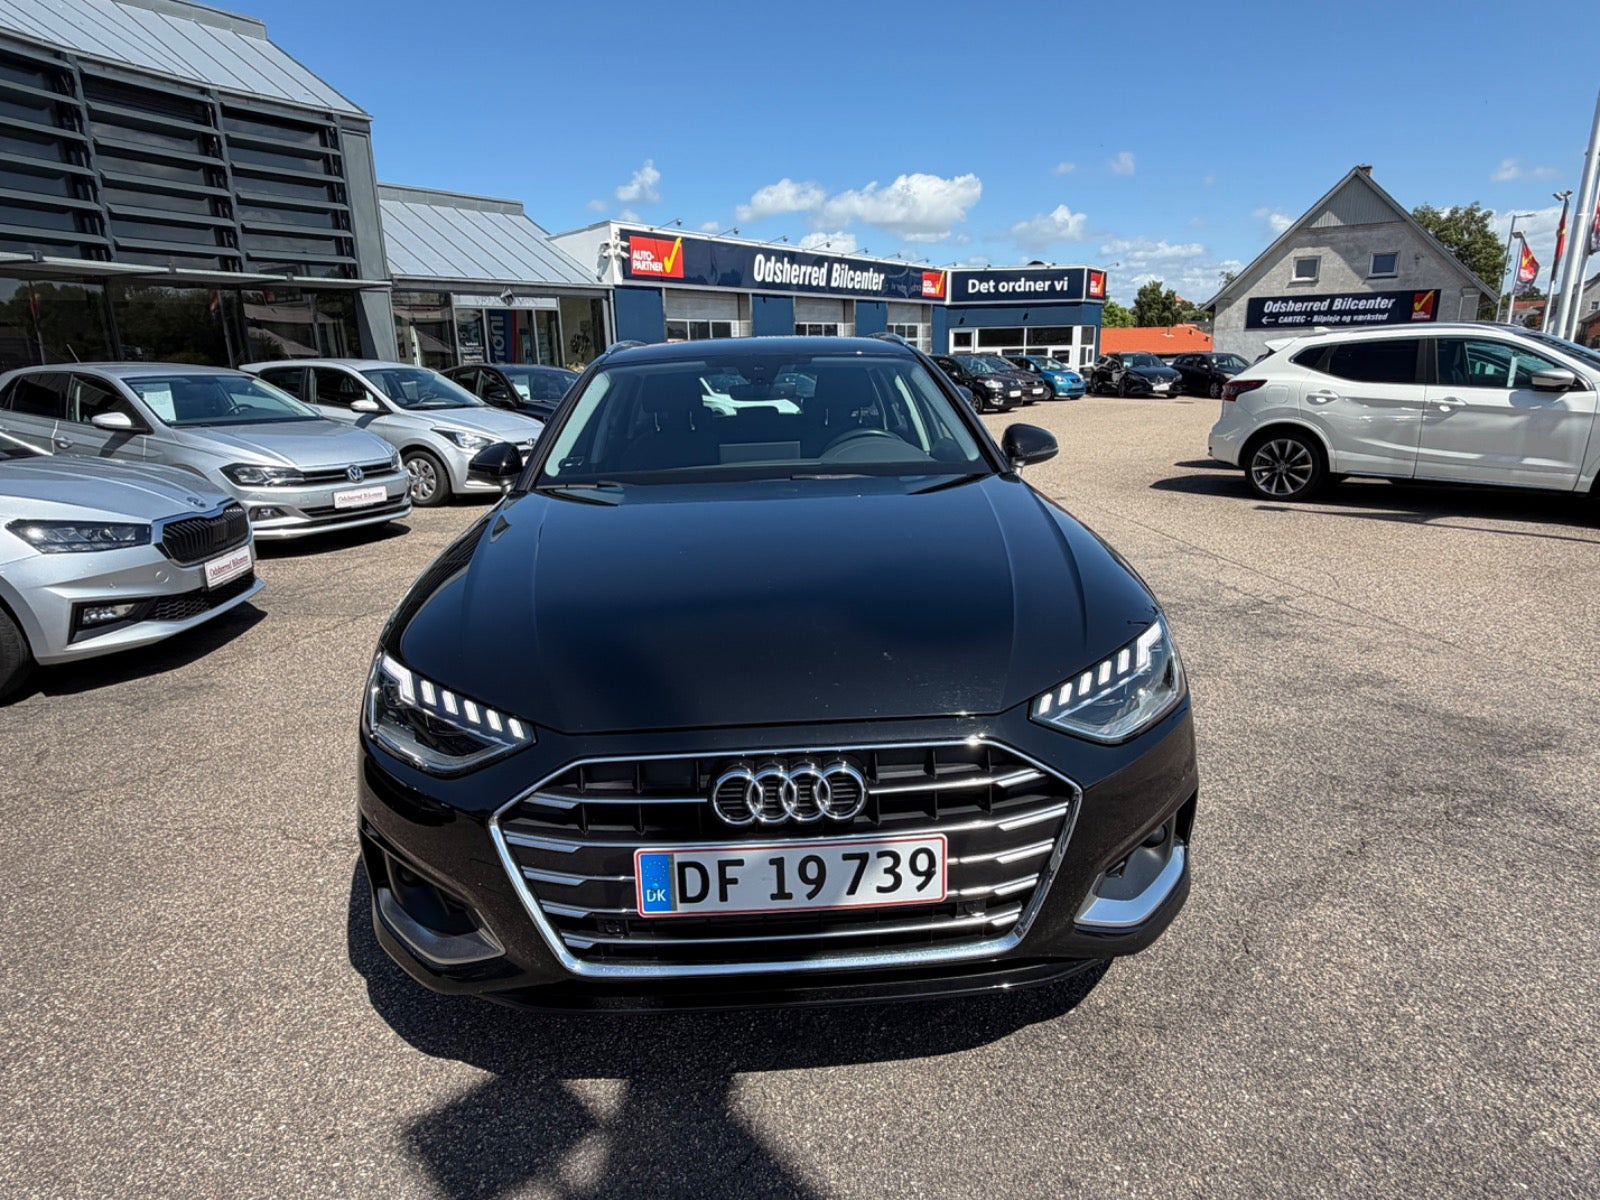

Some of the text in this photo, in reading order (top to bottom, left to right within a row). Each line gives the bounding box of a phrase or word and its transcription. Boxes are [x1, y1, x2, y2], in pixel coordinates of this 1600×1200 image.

[632, 249, 655, 261] AUTO-
[632, 260, 664, 272] PARTNER
[753, 253, 885, 291] Odsherred Bilcenter
[967, 276, 1069, 293] Det ordner vi
[1264, 296, 1396, 314] Odsherred Bilcenter
[1341, 315, 1352, 323] og
[676, 847, 937, 904] DF 19 739
[646, 888, 667, 902] DK
